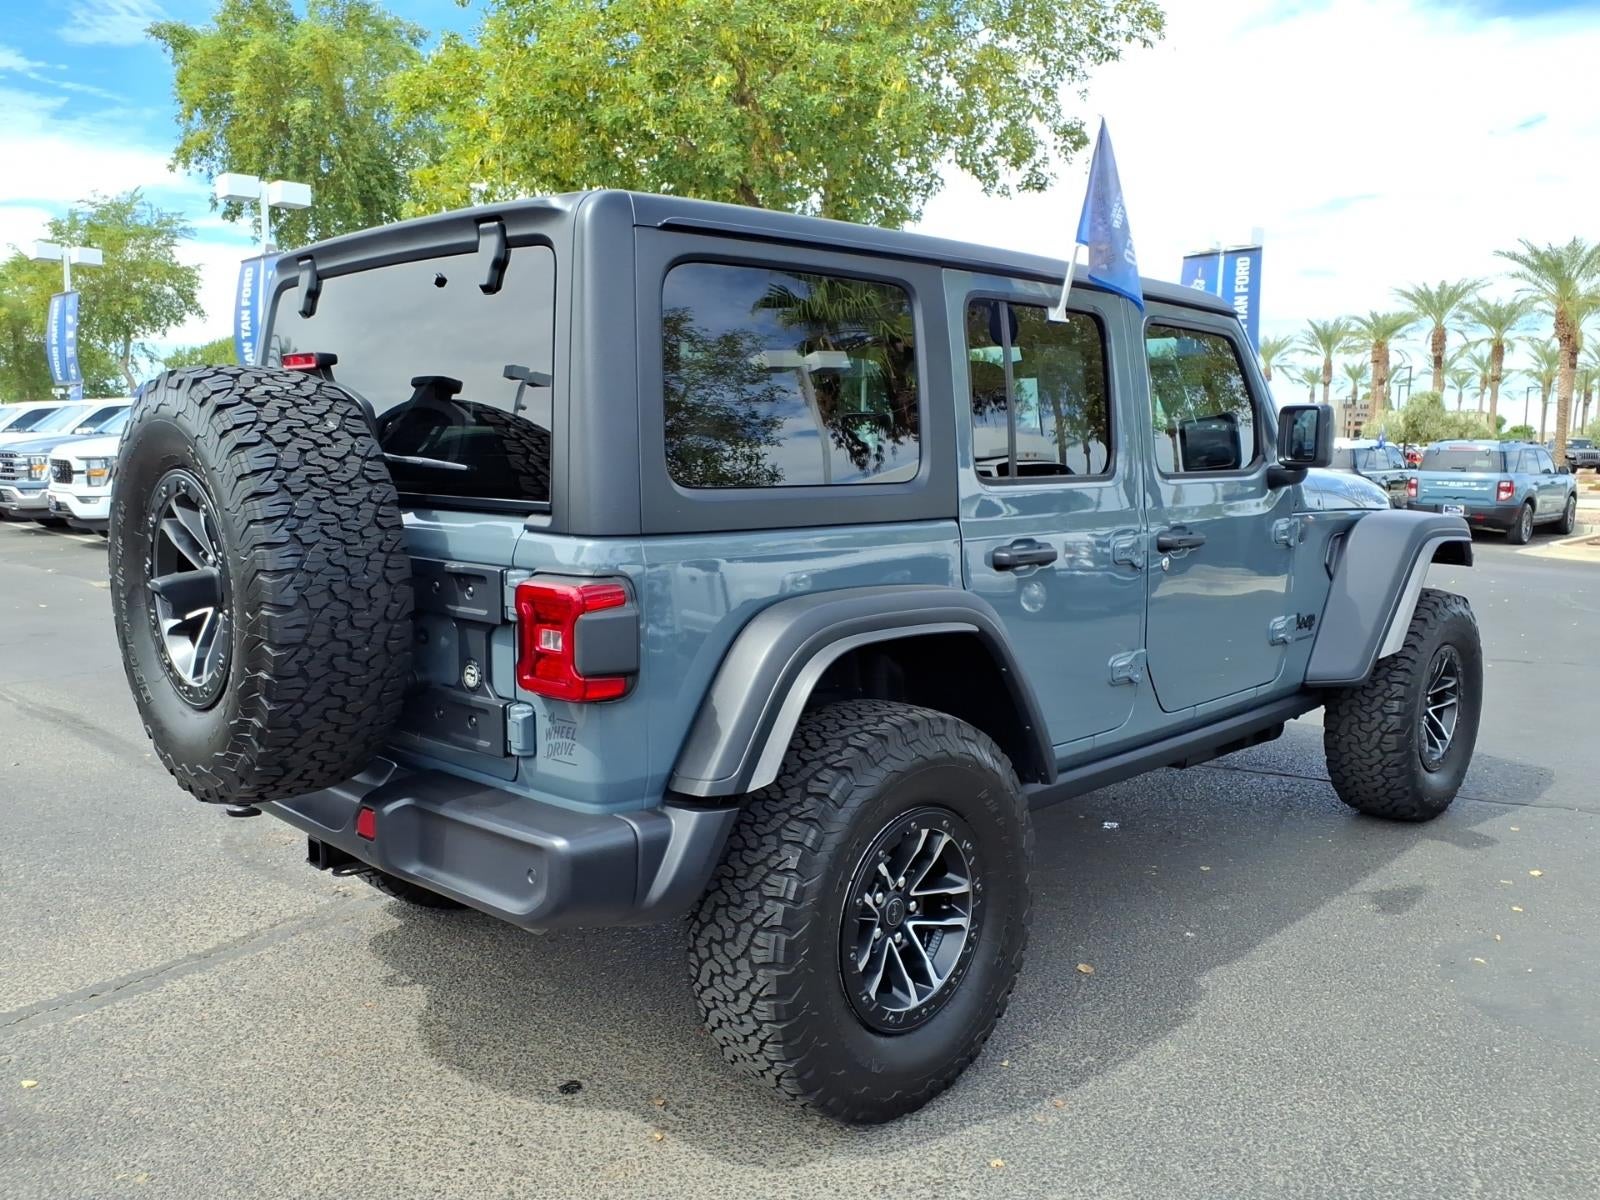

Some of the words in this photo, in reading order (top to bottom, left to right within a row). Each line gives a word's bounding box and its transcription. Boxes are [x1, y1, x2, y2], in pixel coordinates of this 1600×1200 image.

[241, 266, 254, 307] FORD
[1234, 256, 1251, 294] FORD
[240, 309, 253, 340] TAN
[51, 346, 63, 381] PROUD
[243, 341, 255, 366] AN
[547, 711, 556, 724] 4
[545, 726, 577, 742] WHEEL
[546, 742, 577, 759] DRIVE
